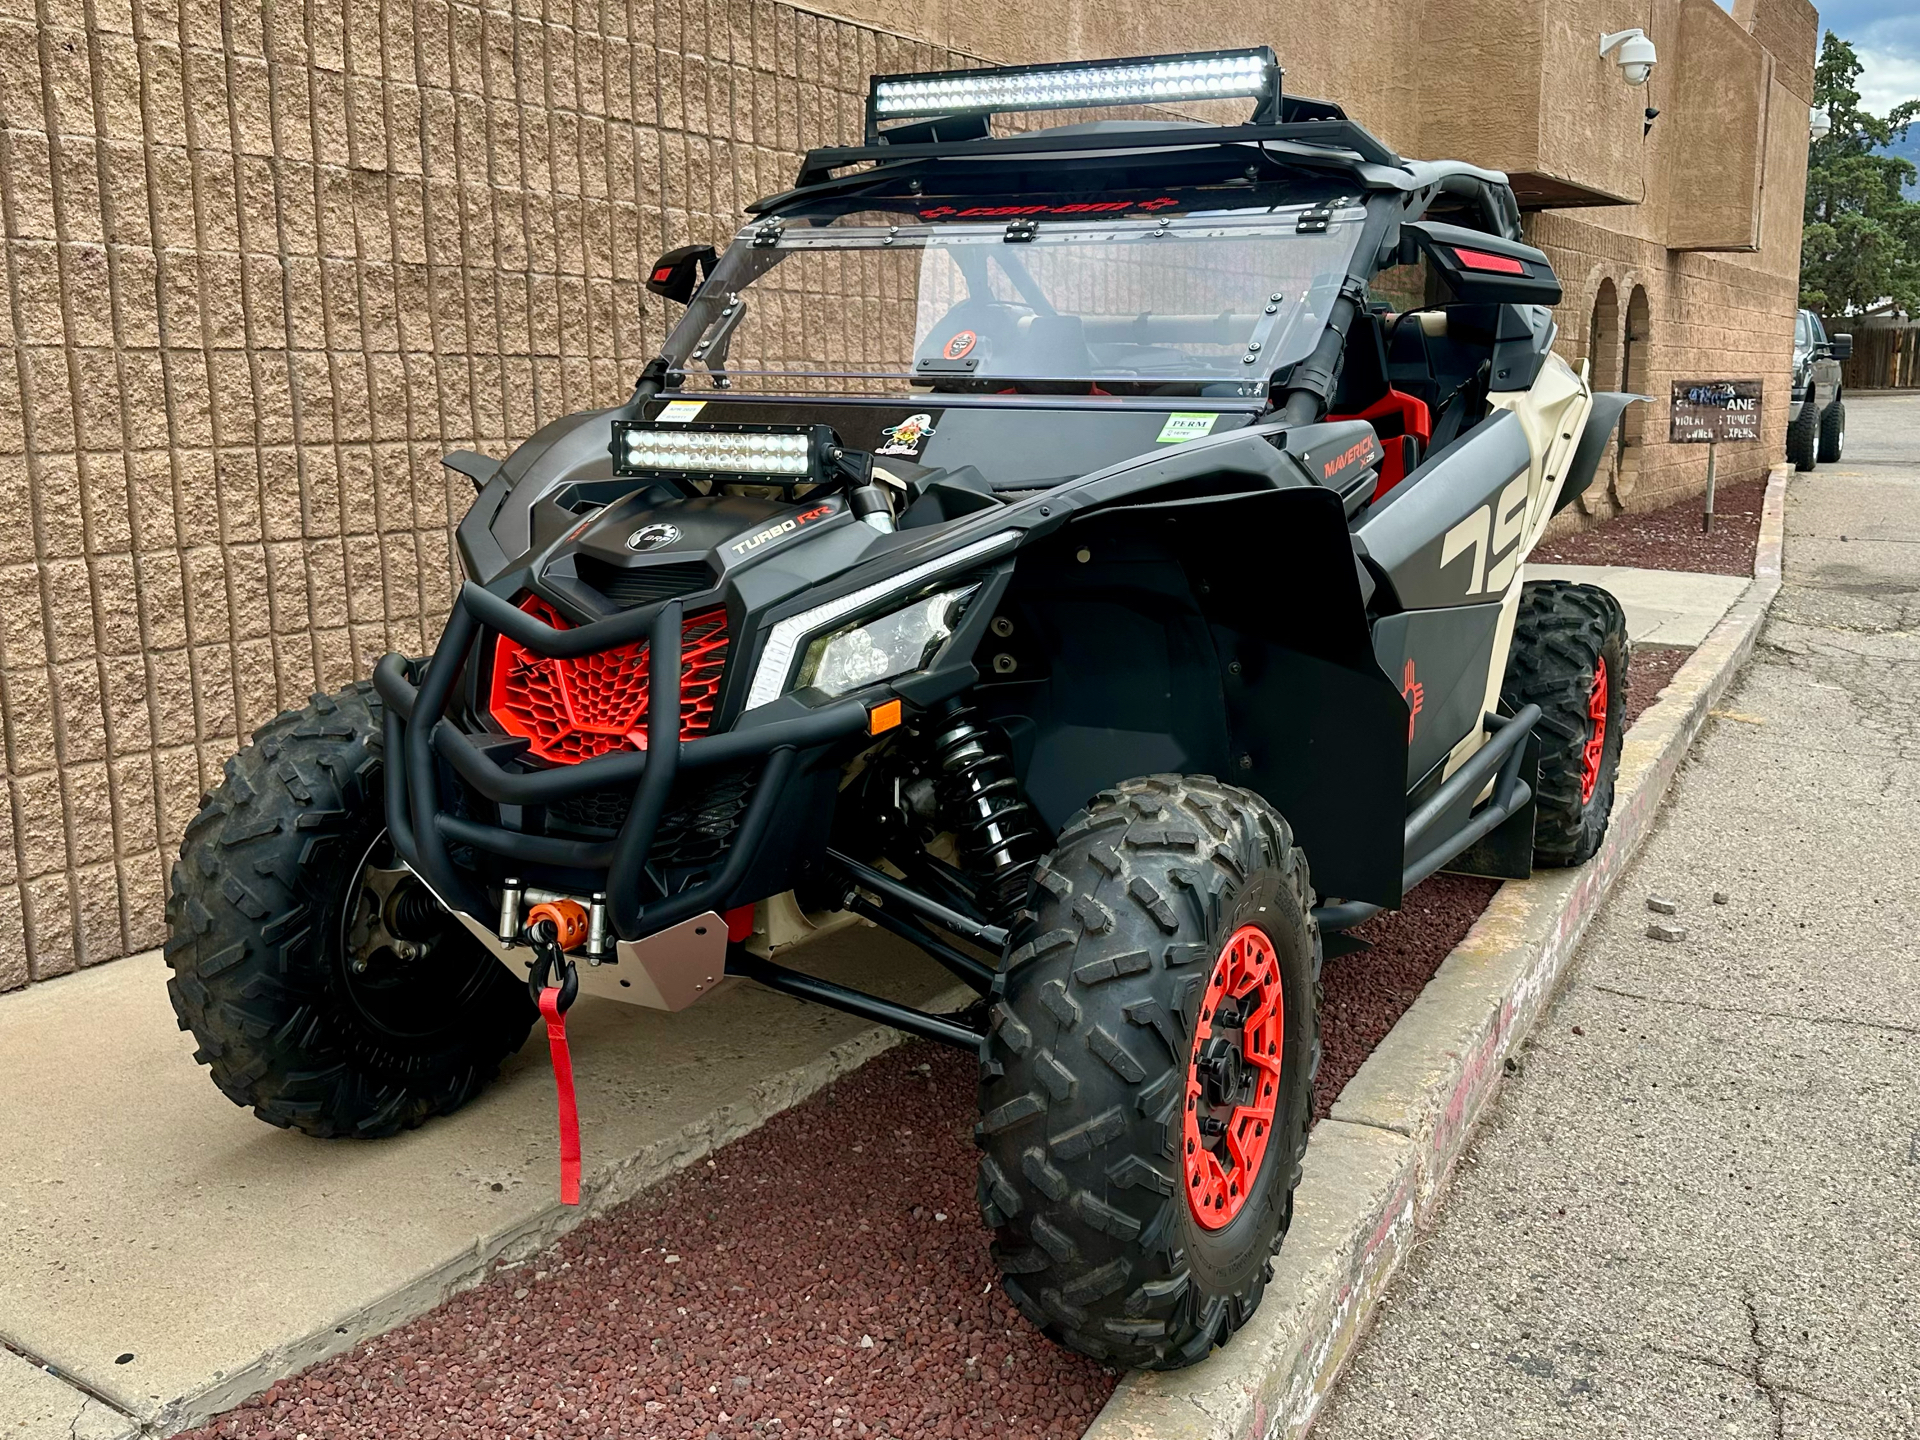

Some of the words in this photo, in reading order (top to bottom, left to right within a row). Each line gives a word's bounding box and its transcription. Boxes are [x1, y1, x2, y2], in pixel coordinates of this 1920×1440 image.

[1722, 398, 1757, 411] ANE
[1172, 420, 1207, 428] PERM
[1324, 434, 1374, 479] MAVERICK
[732, 519, 797, 555] TURBO
[796, 504, 834, 525] RR
[643, 534, 671, 542] BRP
